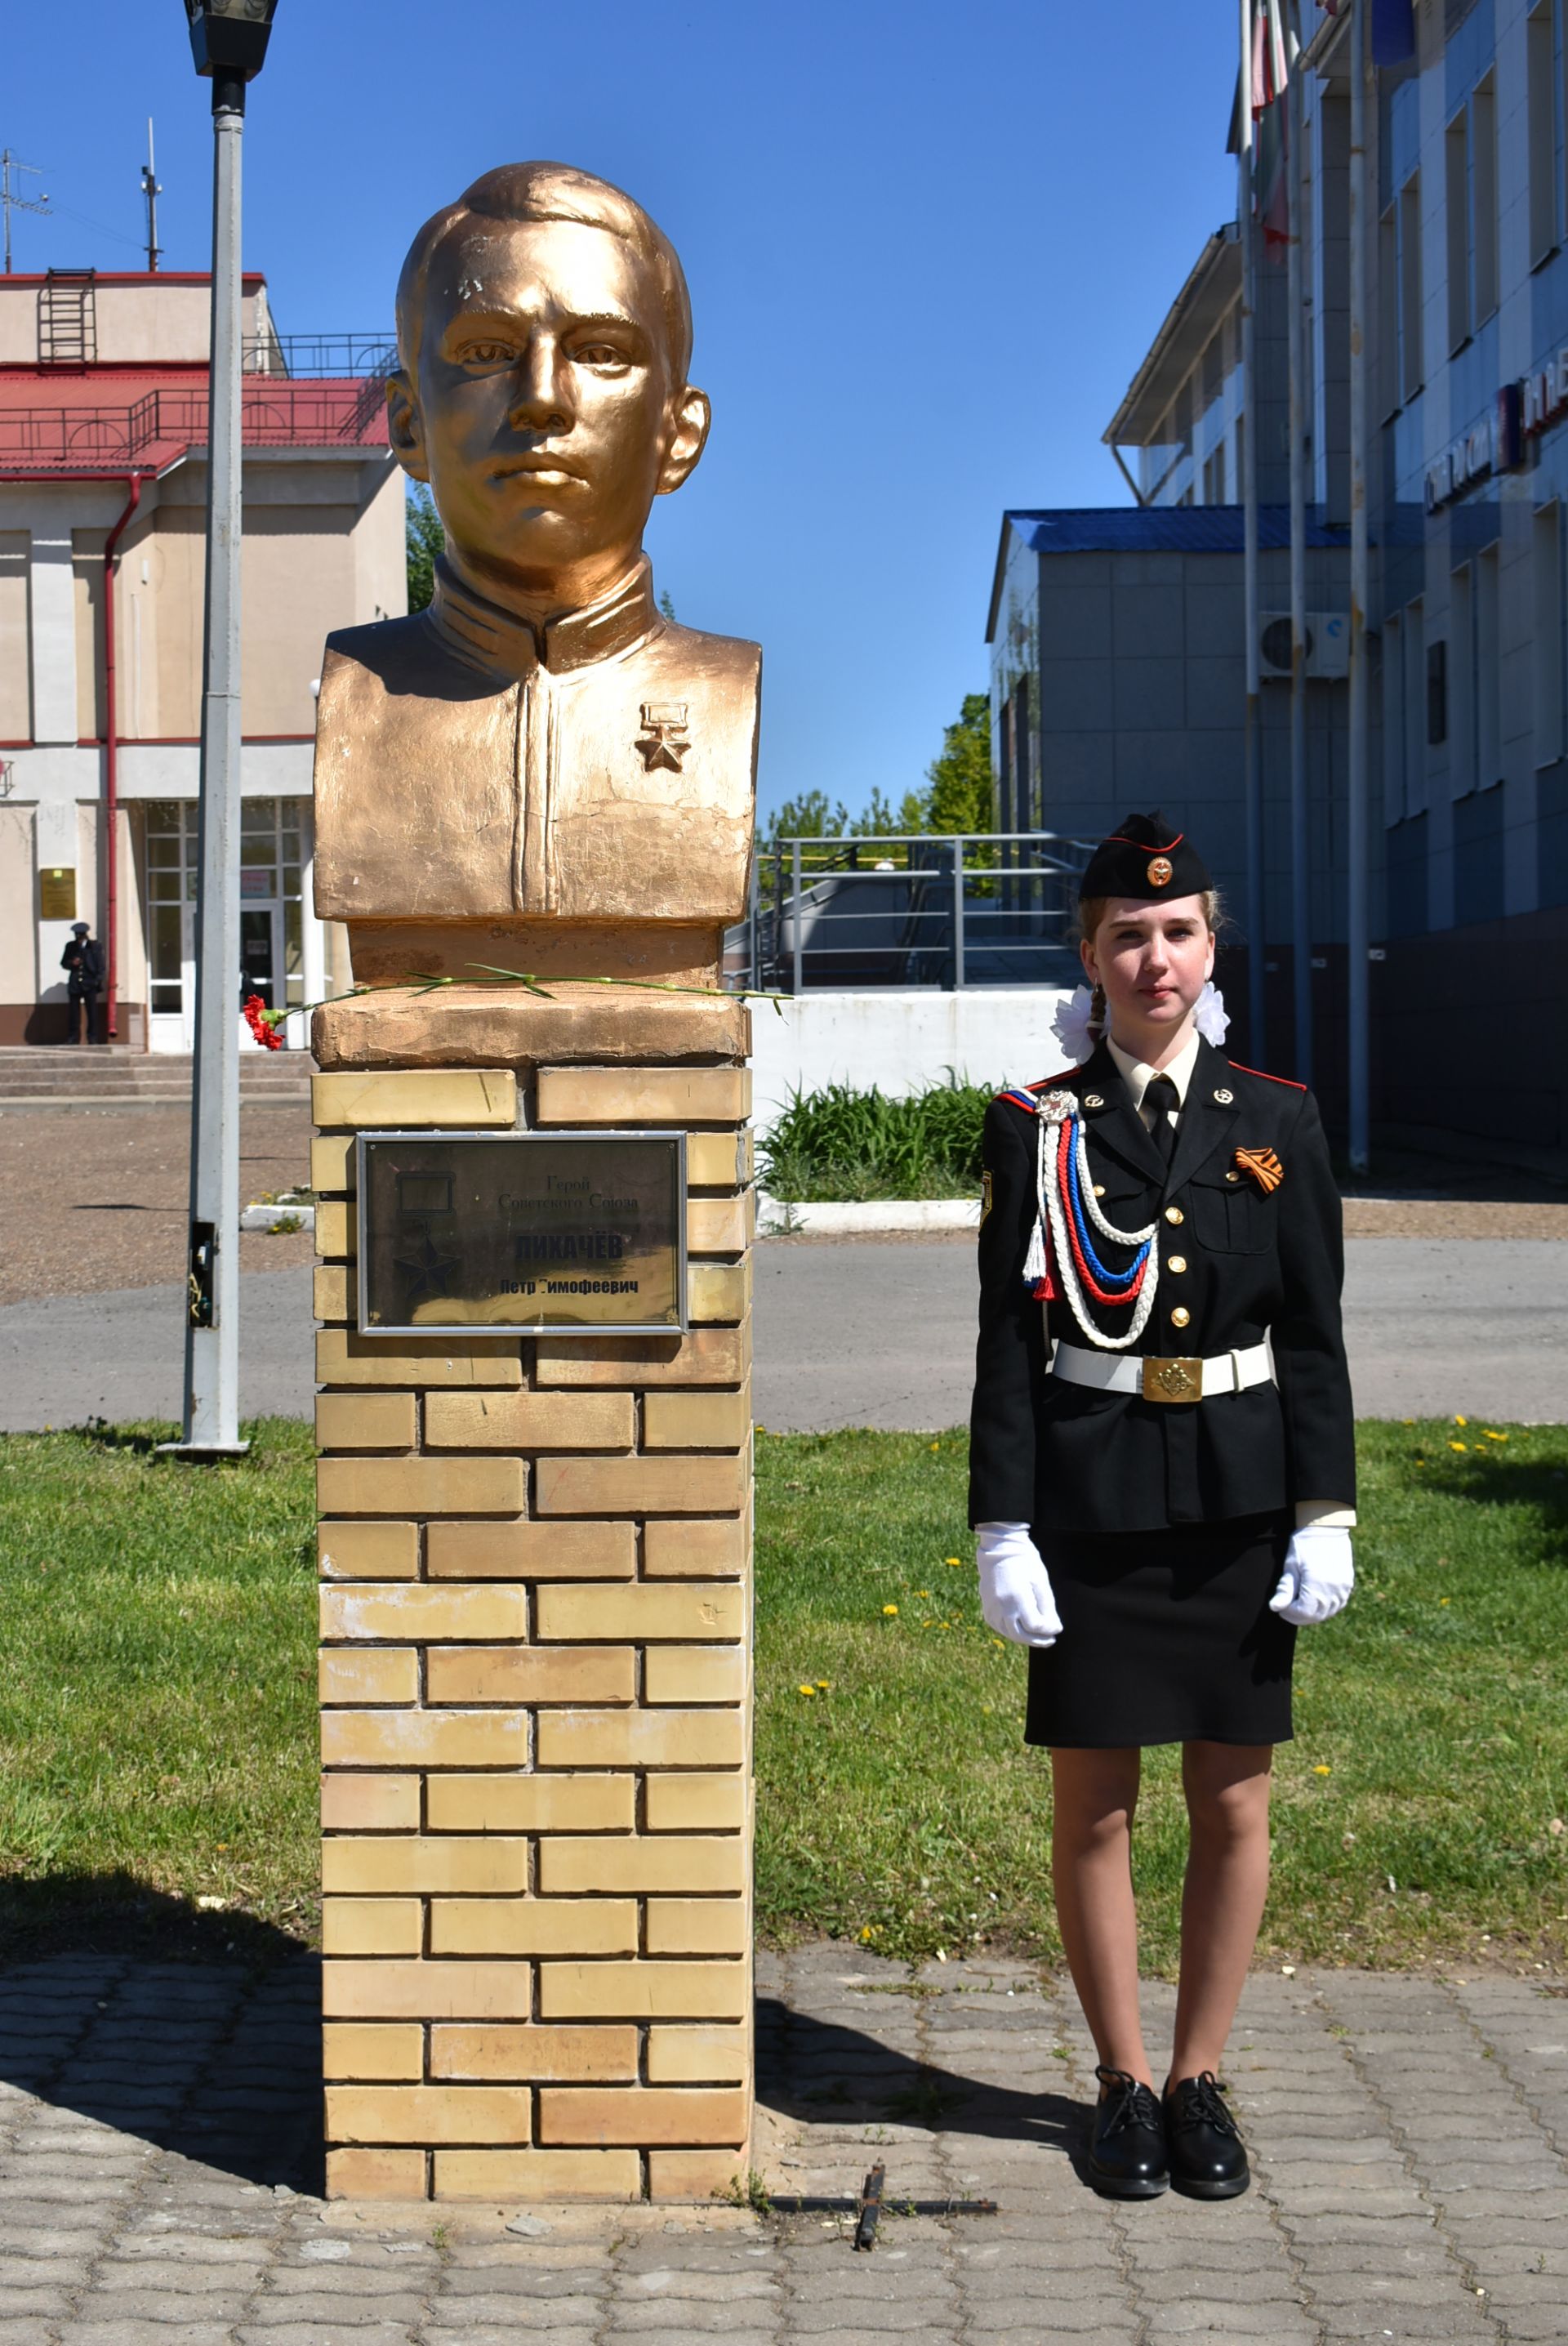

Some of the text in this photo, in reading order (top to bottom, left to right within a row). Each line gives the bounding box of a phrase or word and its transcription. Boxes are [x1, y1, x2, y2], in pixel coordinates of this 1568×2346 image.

[546, 1175, 590, 1193] Герой
[497, 1193, 639, 1210] Советского Союза
[515, 1230, 623, 1260] ЛИХАЧЁВ
[500, 1278, 536, 1296] Петр
